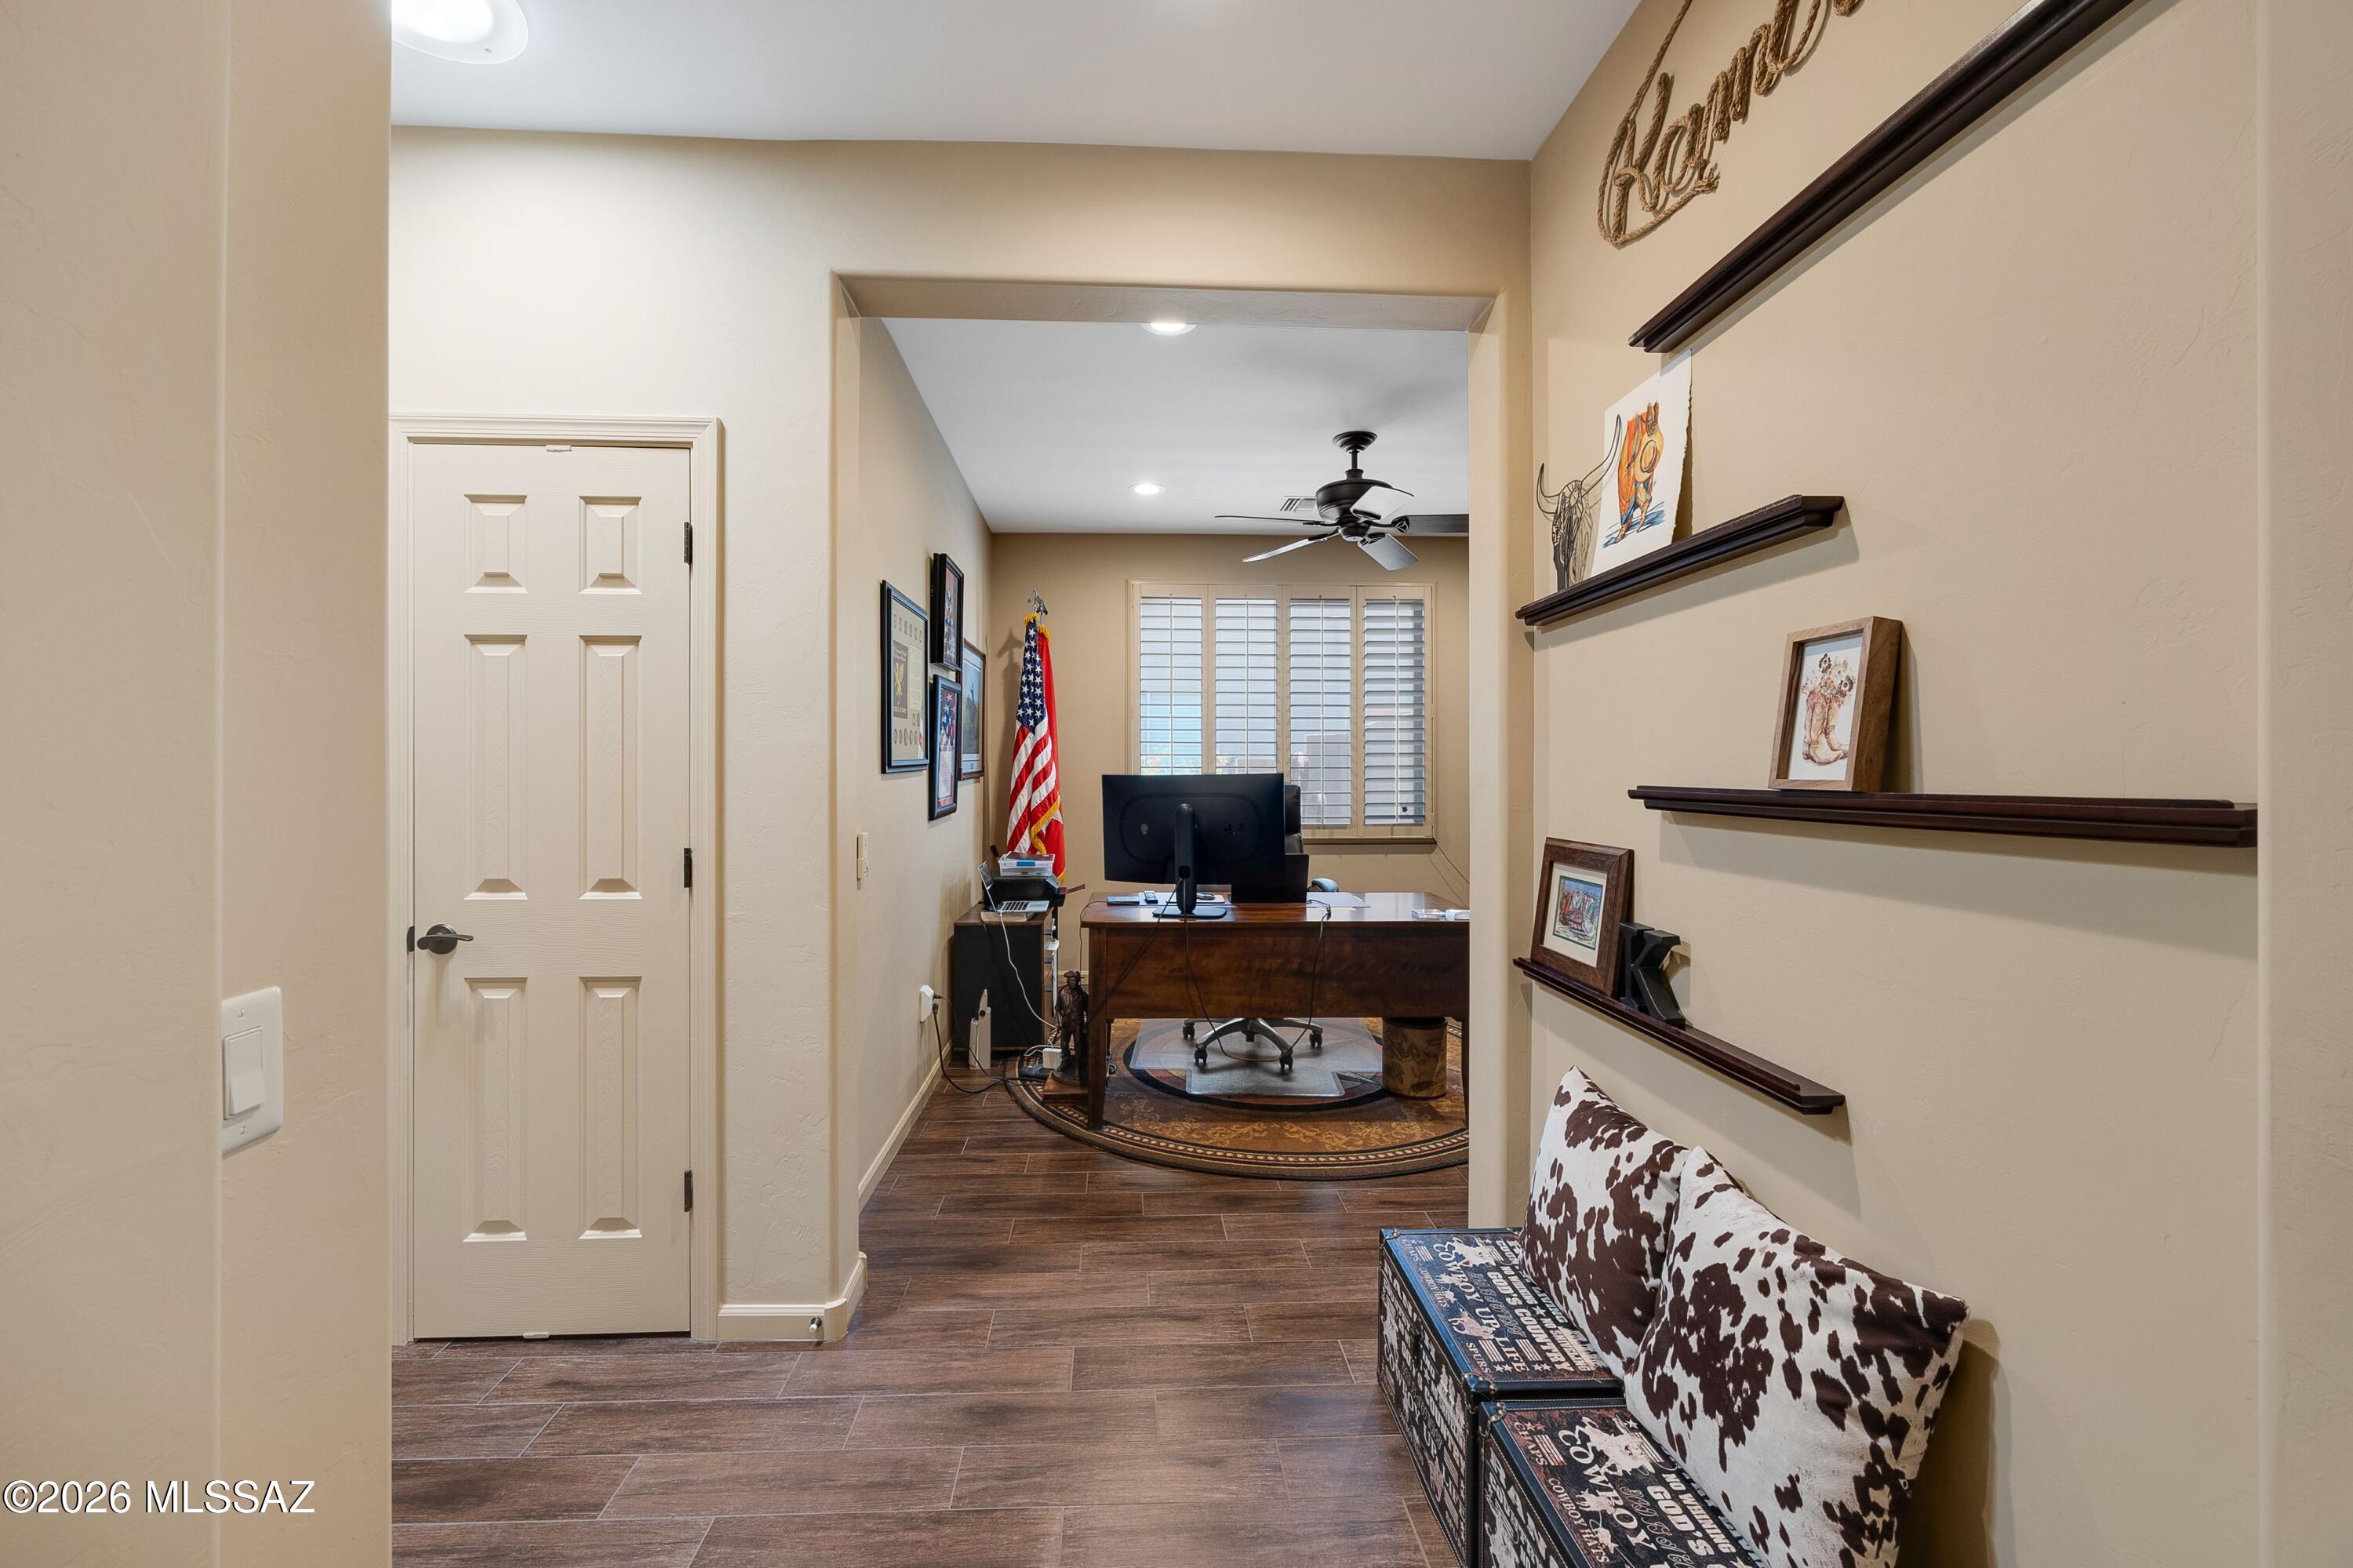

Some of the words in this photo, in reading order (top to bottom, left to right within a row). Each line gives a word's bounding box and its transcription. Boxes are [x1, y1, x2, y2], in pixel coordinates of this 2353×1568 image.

[1620, 922, 1686, 1029] K
[1401, 1239, 1421, 1261] CHAPS
[1500, 1266, 1515, 1275] NO
[1431, 1243, 1484, 1301] COWBOY
[1473, 1307, 1501, 1328] UP
[1494, 1337, 1530, 1372] LIFE
[1486, 1271, 1523, 1305] GOD'S
[1513, 1308, 1575, 1371] COUNTRY
[1507, 1275, 1538, 1304] WHINING
[1540, 1318, 1558, 1328] NO
[1464, 1342, 1491, 1372] SPURS
[1511, 1421, 1548, 1465] CHAPS
[1547, 1478, 1587, 1525] COWBOY
[1578, 1528, 1609, 1562] HATS
[1554, 1429, 1657, 1549] COWBOY
[1645, 1486, 1716, 1555] GOD'S
[1661, 1474, 1686, 1490] NO
[1678, 1493, 1737, 1552] WHINING
